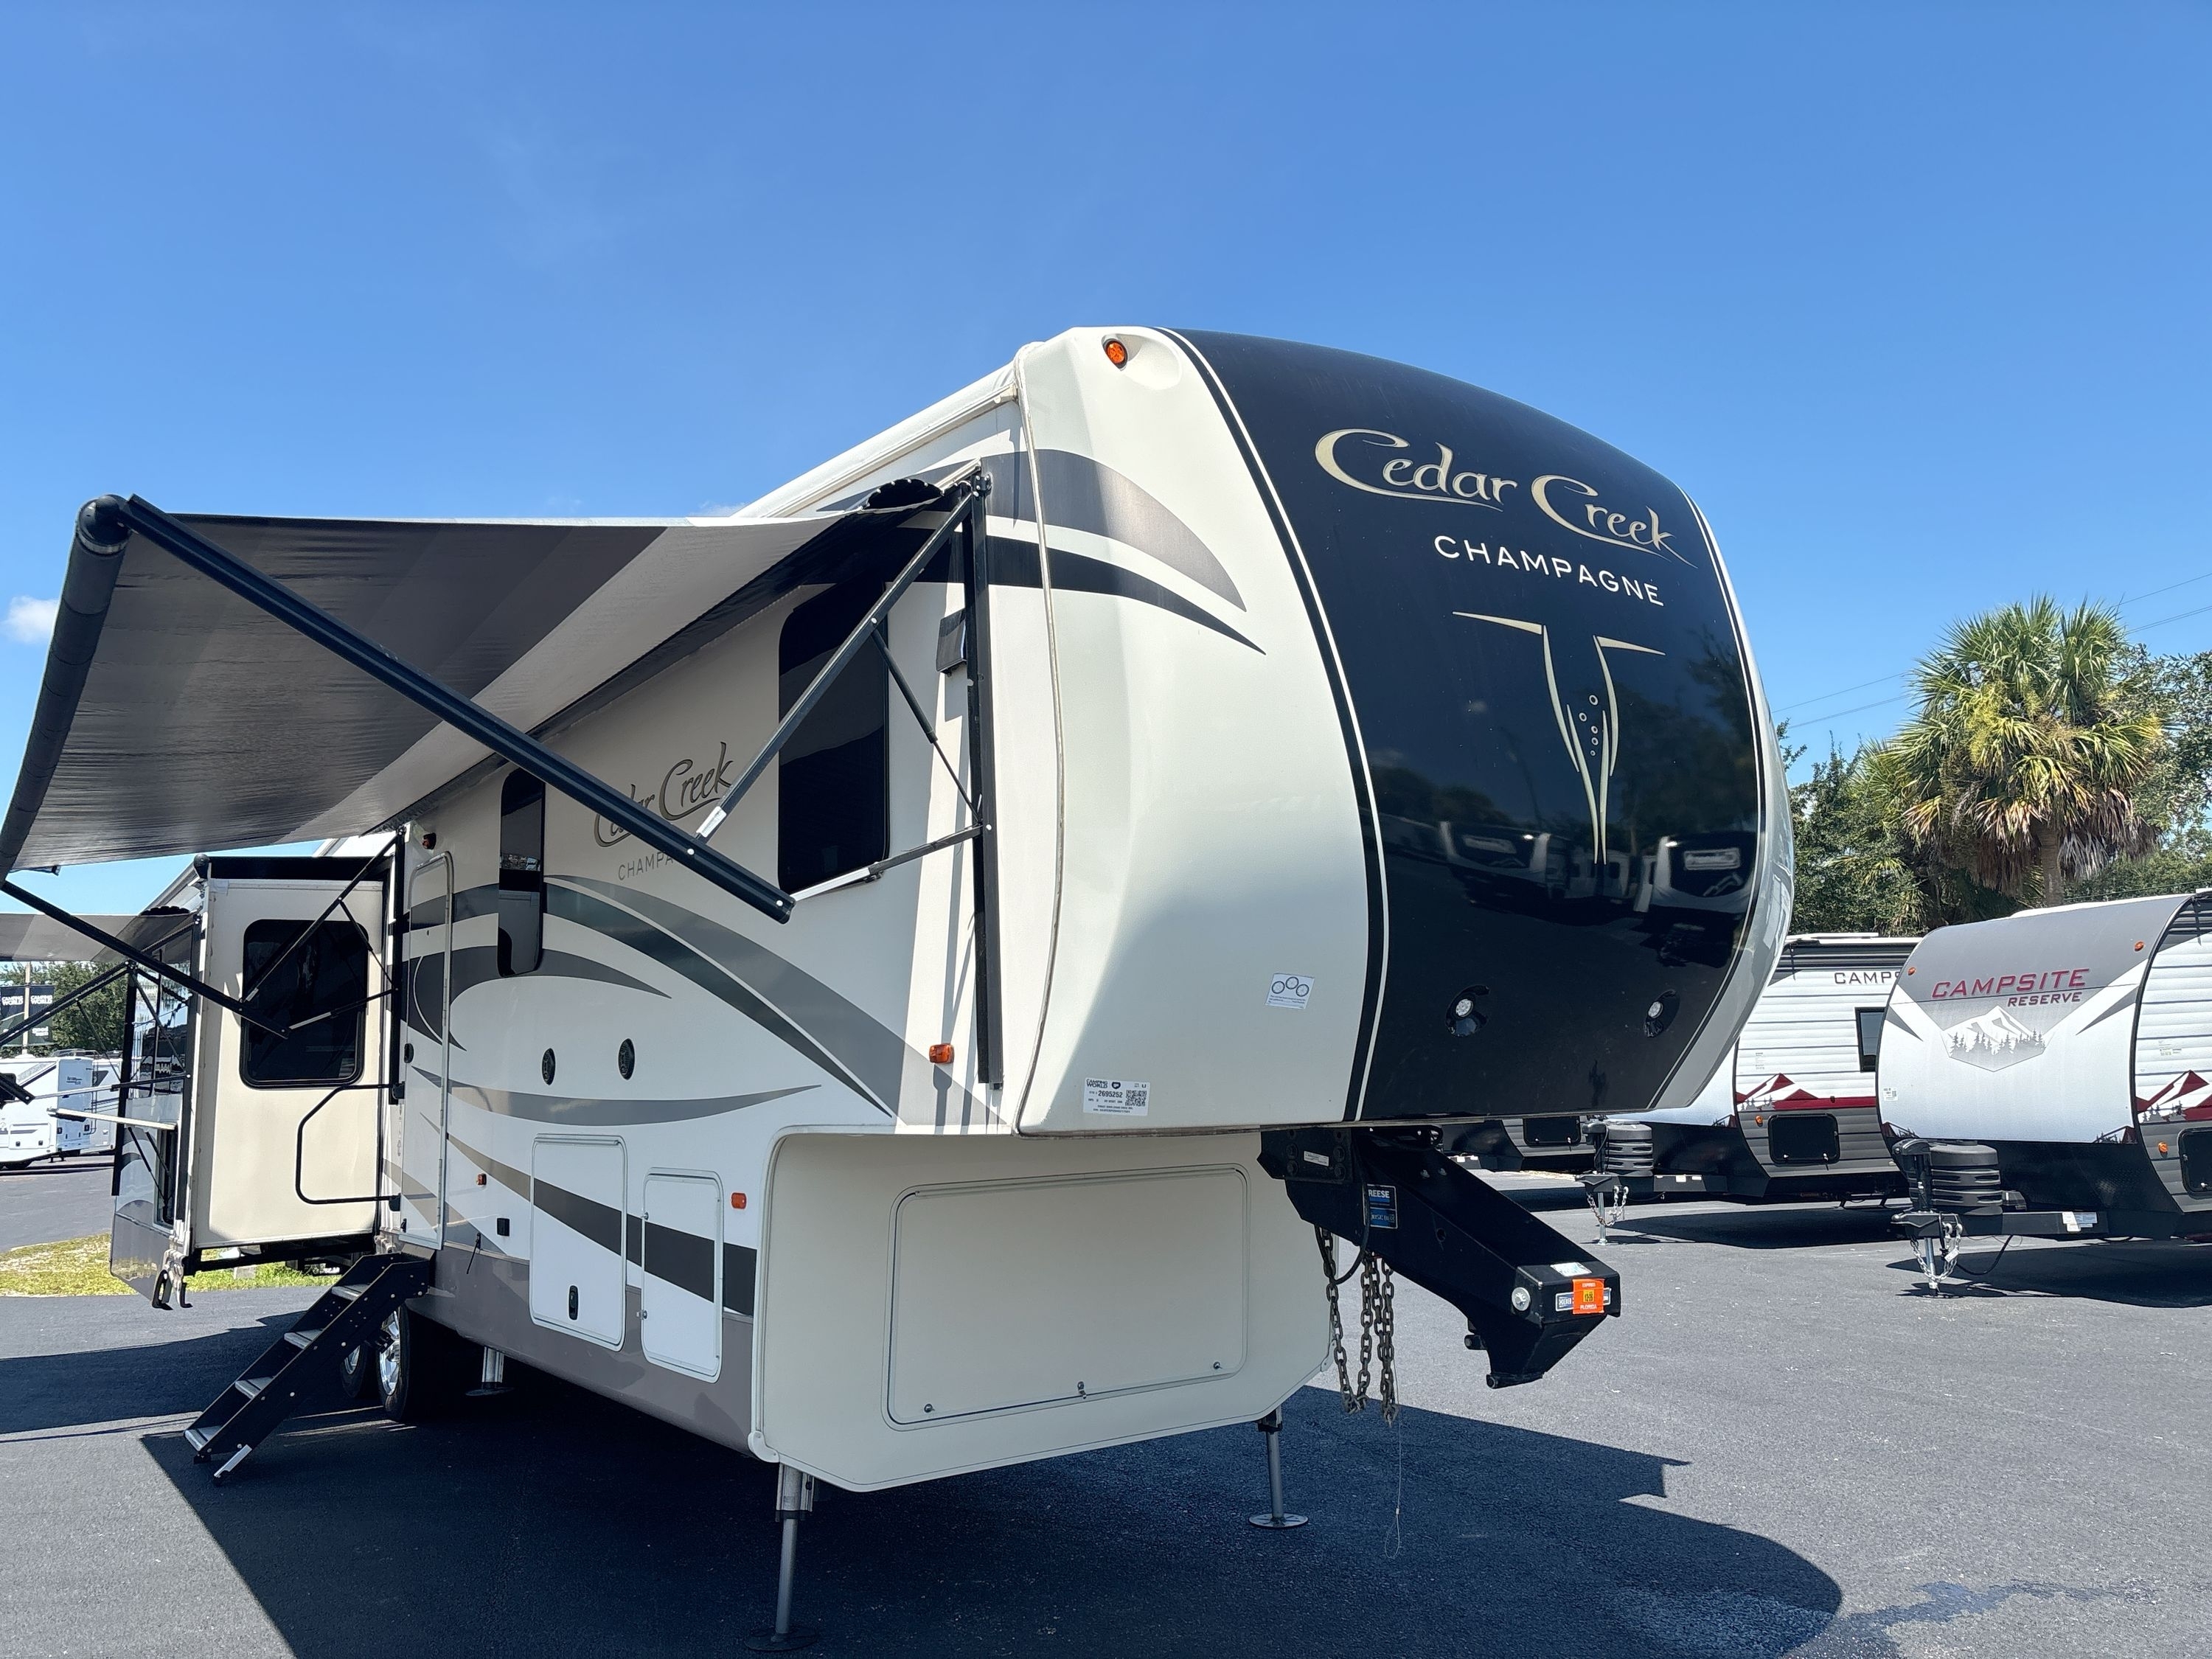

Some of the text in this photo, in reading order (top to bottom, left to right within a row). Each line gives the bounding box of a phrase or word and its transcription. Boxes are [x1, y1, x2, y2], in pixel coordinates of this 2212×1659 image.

[1315, 428, 1698, 568] Cedar Creek
[1434, 535, 1664, 606] CHAMPAGNE
[658, 741, 734, 821] Creek
[1931, 968, 2090, 999] CAMPSITE
[2007, 992, 2090, 1007] RESERVE
[1098, 1090, 1123, 1098] 2695252
[1368, 1189, 1391, 1198] REESE
